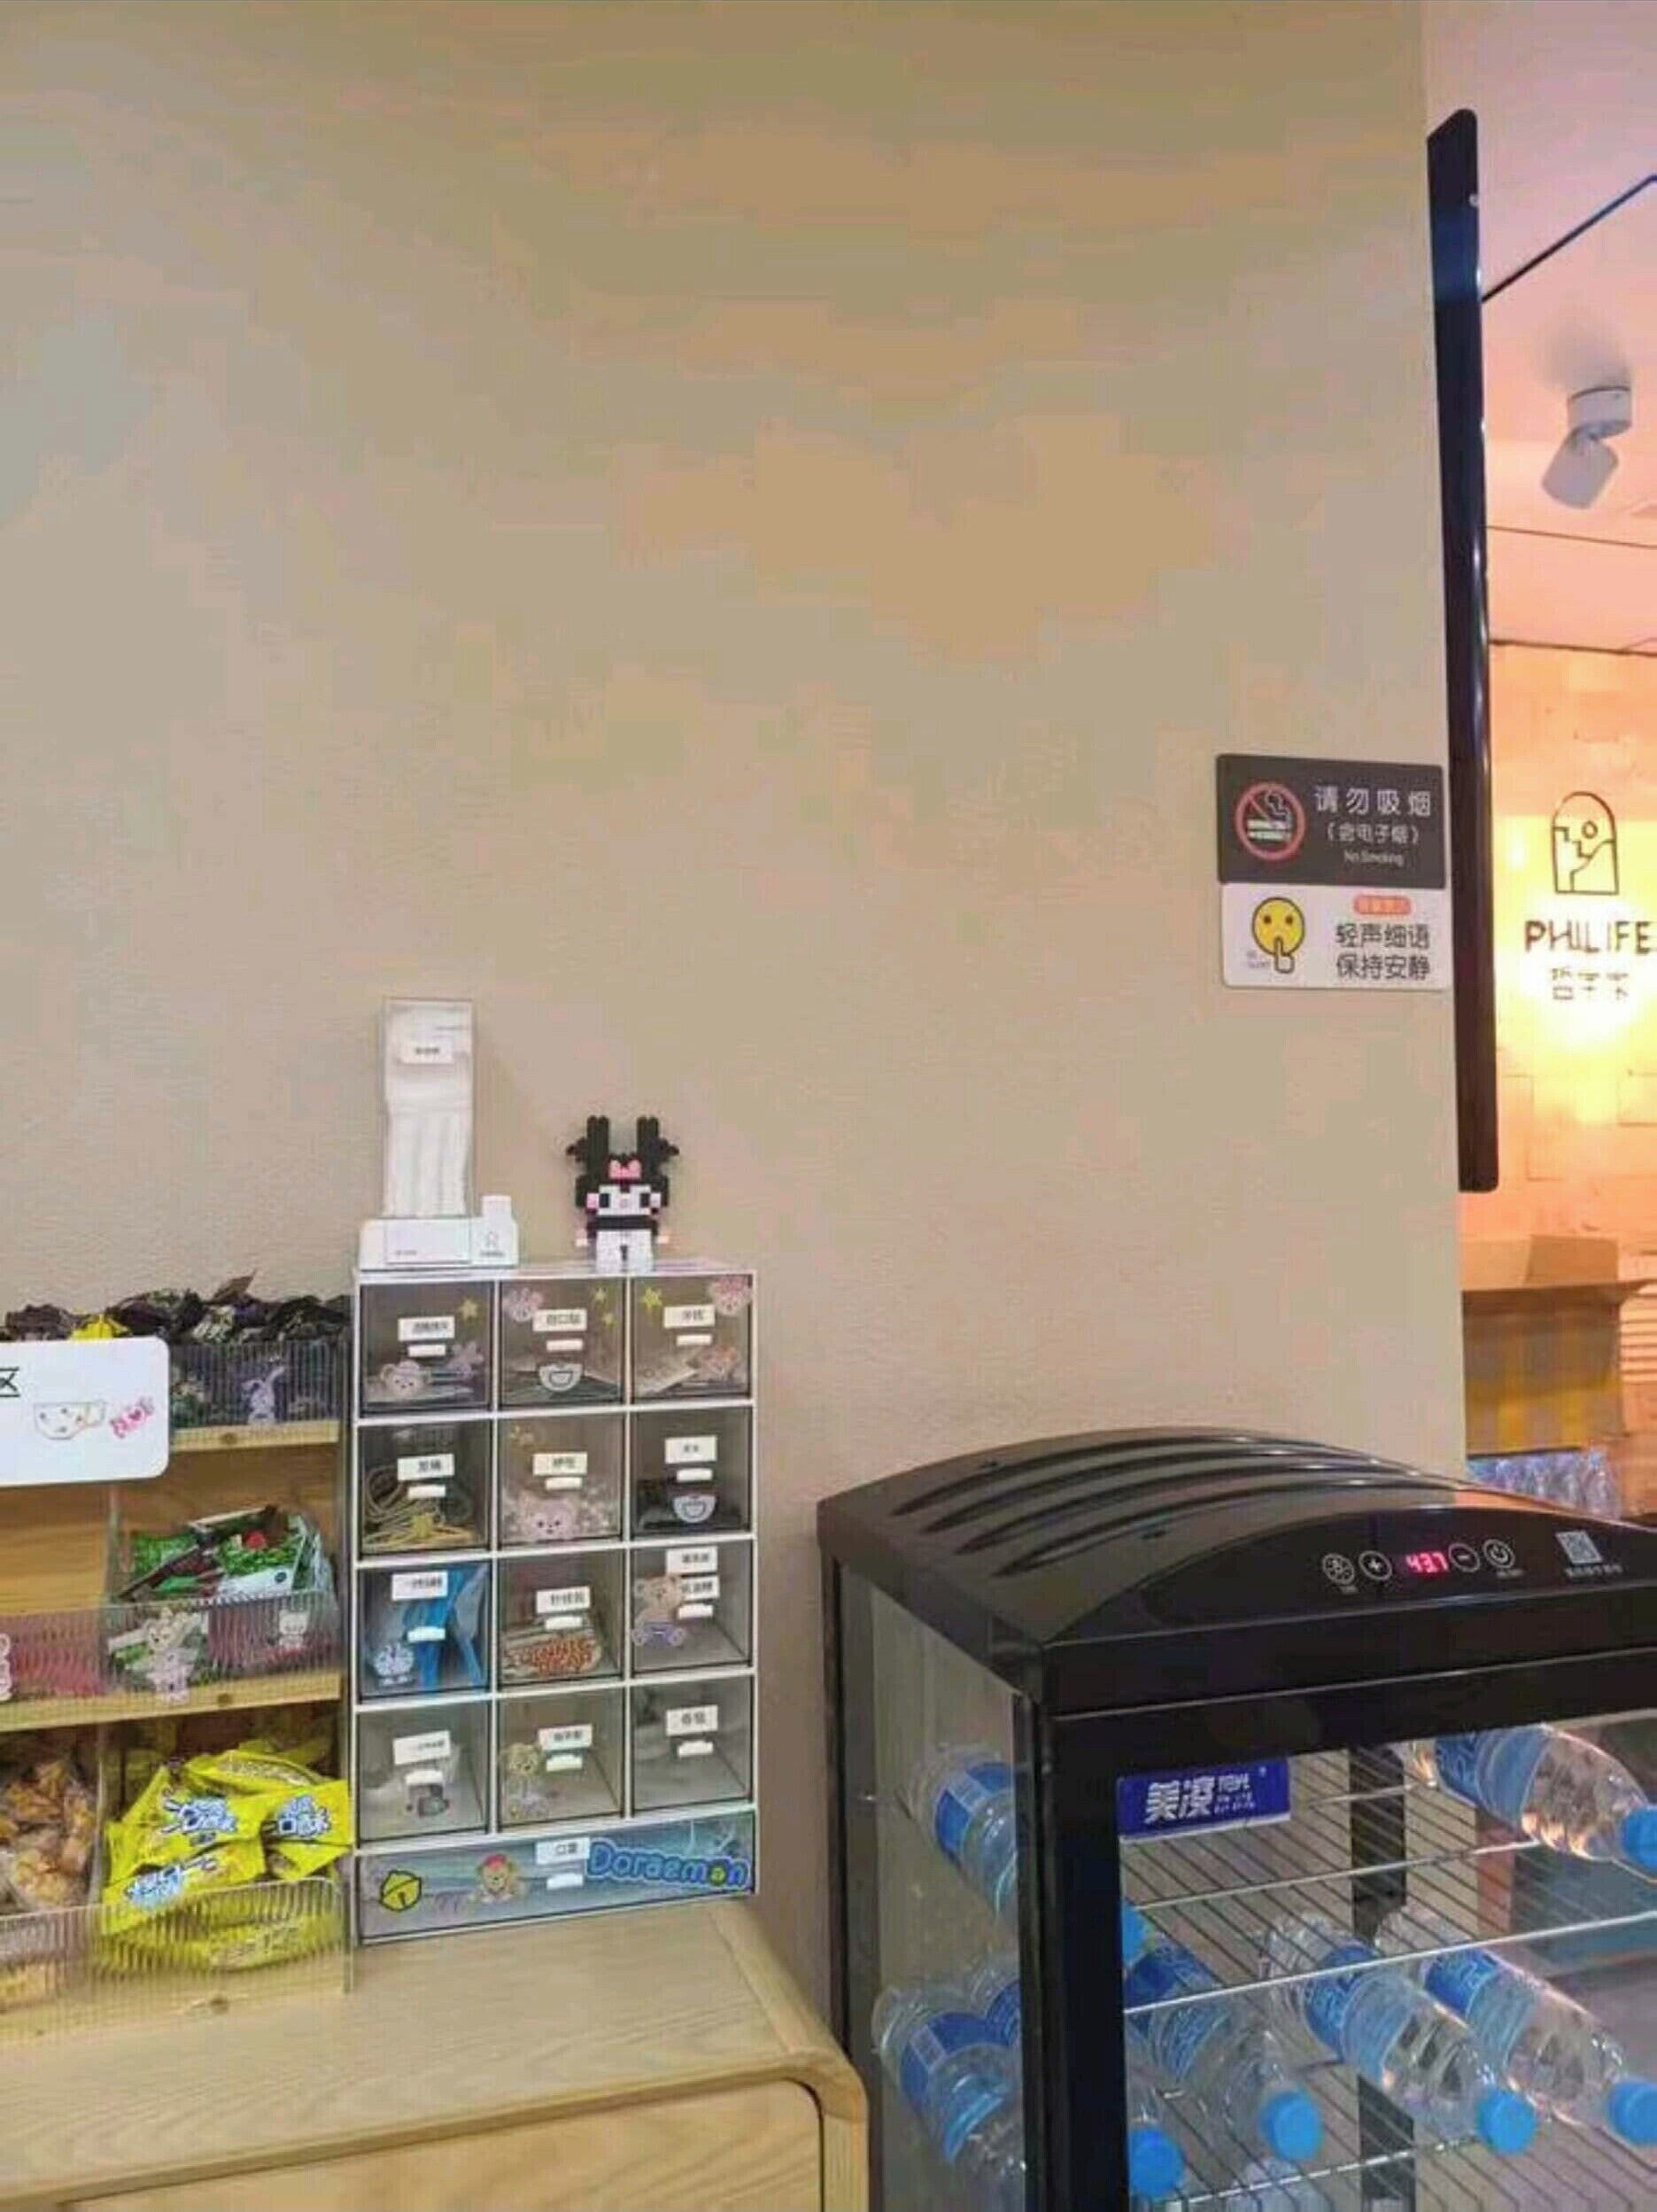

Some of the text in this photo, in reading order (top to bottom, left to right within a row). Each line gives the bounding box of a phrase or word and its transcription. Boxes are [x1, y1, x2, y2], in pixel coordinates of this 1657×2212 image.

[1315, 785, 1432, 817] 请勿吸烟
[1336, 922, 1430, 950] 轻声细语
[1524, 919, 1653, 955] PHILIFE
[1336, 953, 1430, 981] 保持安静
[586, 1838, 751, 1889] Doraemon
